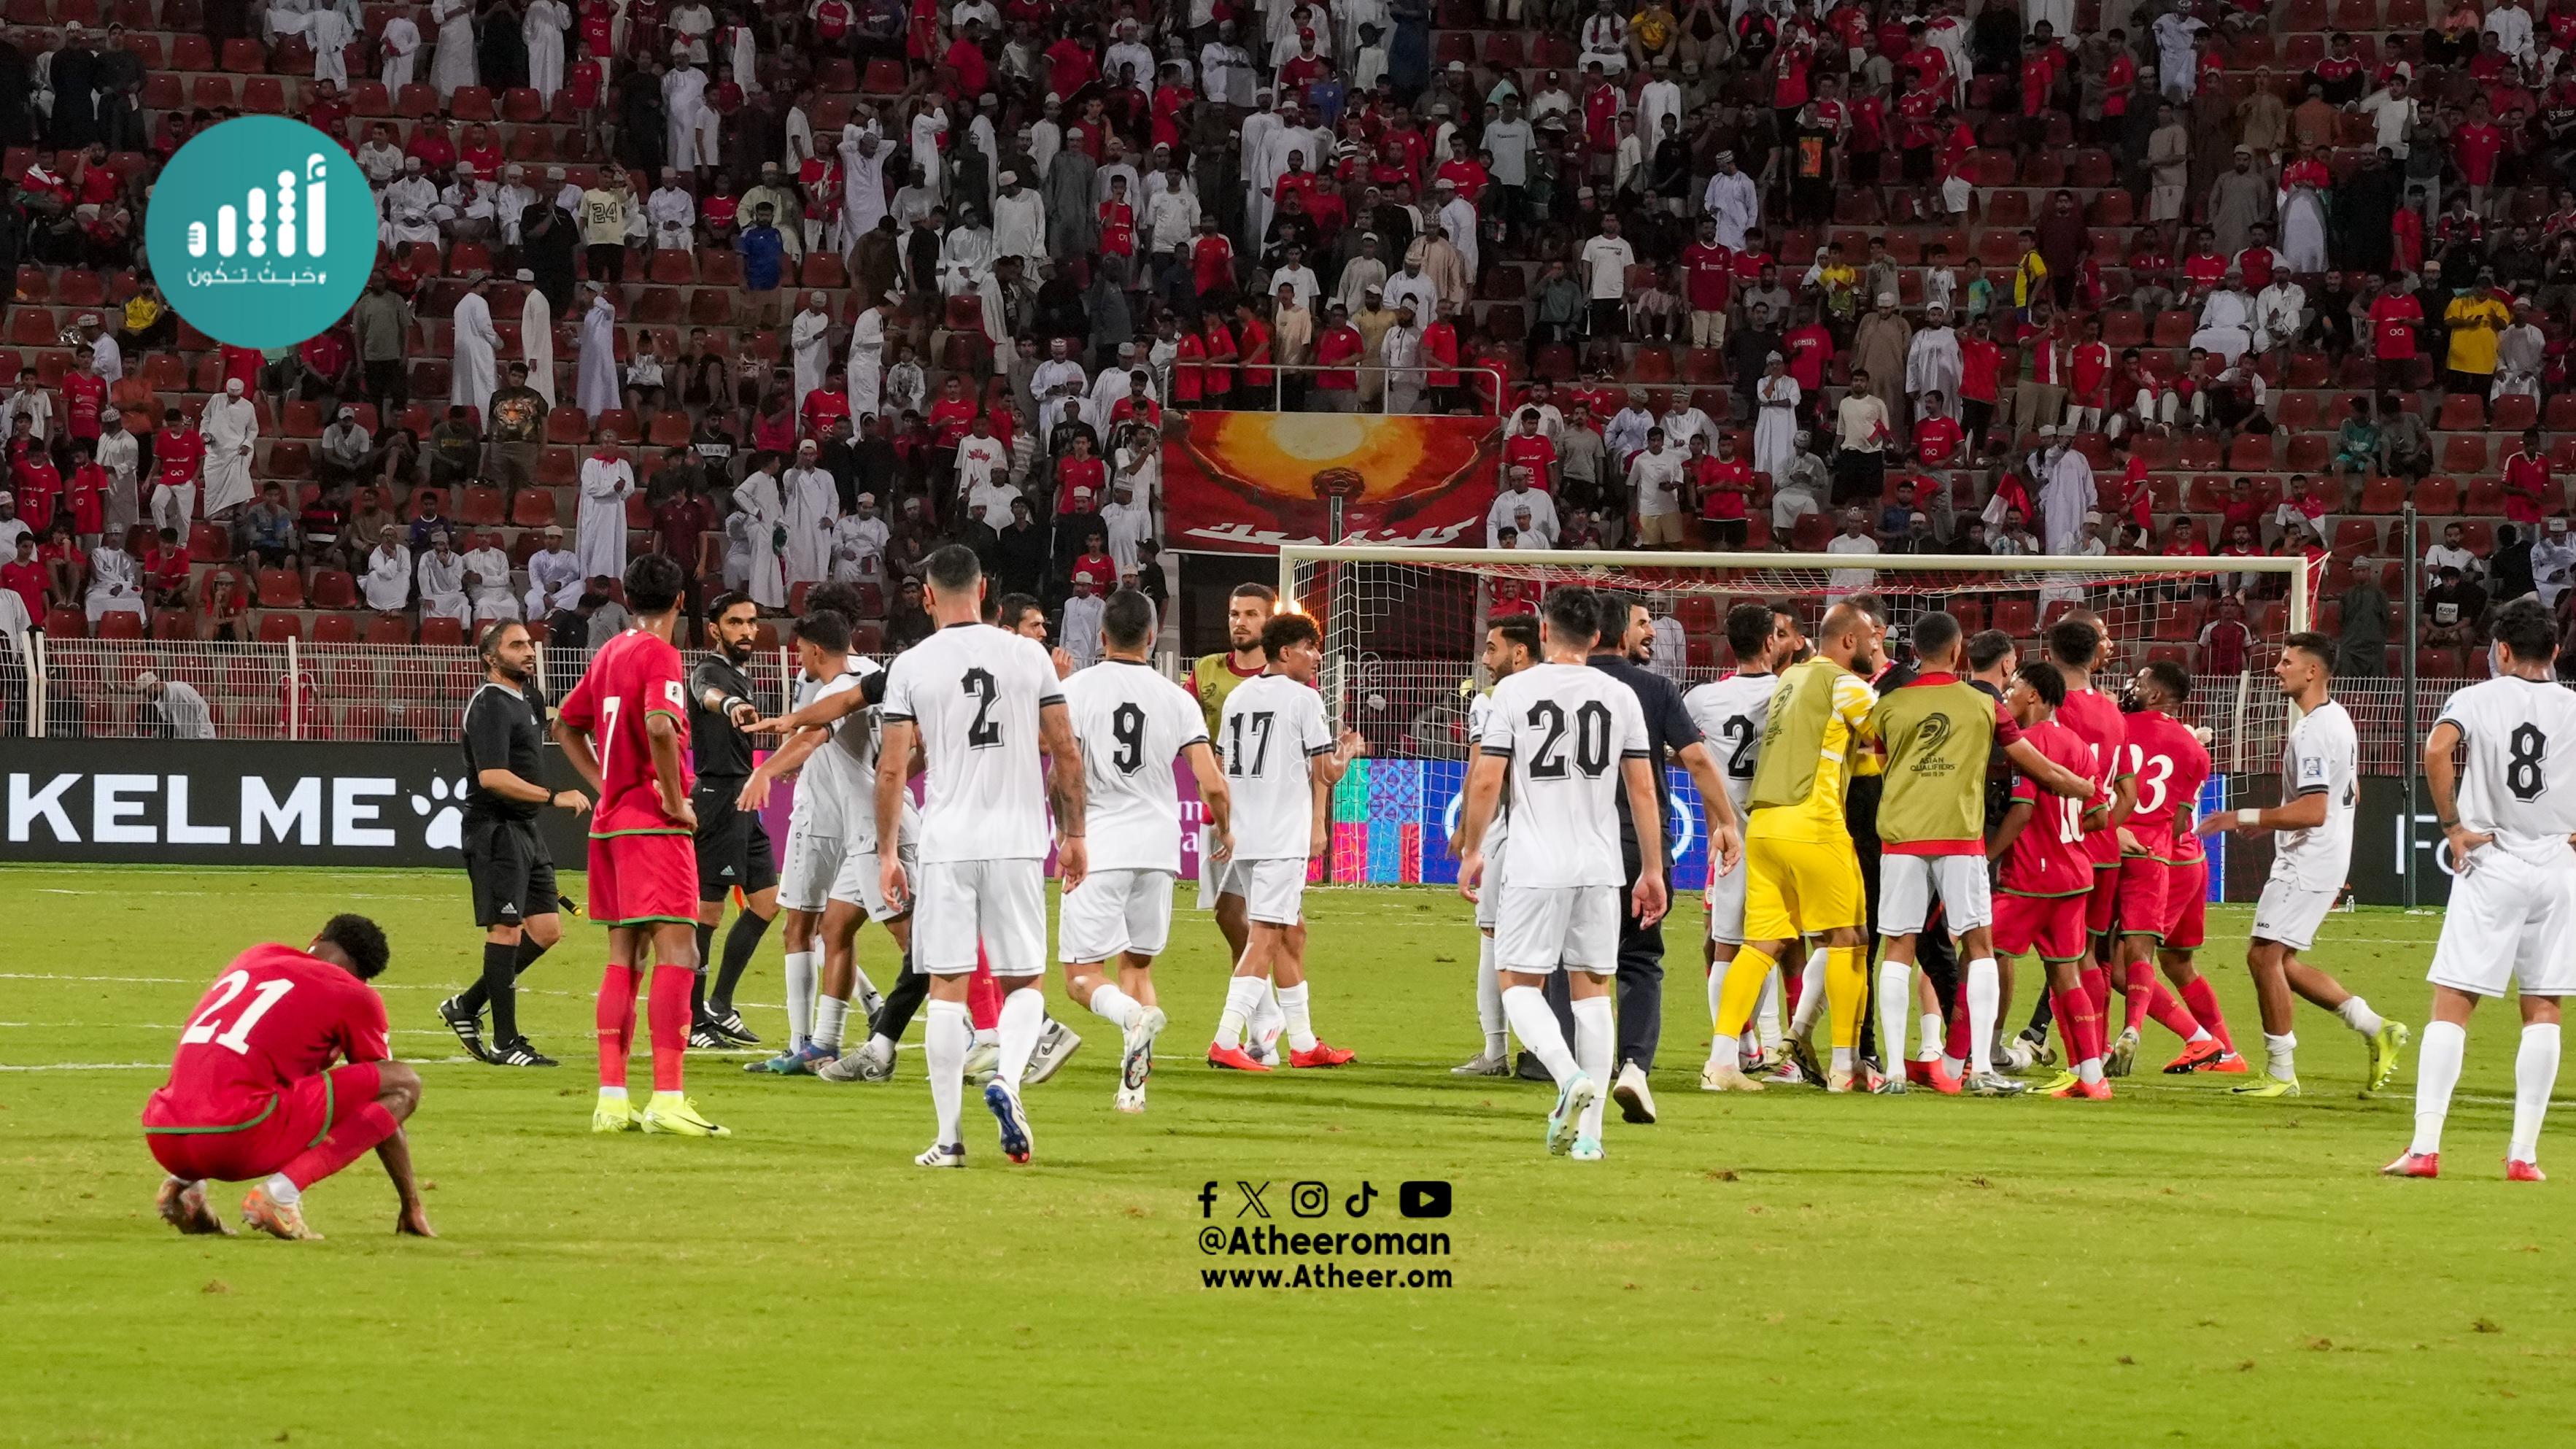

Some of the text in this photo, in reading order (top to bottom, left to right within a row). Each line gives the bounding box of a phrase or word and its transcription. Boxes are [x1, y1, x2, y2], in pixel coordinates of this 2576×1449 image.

[592, 202, 616, 224] 24
[602, 695, 621, 781] 7
[960, 666, 1005, 751] 2
[1113, 701, 1149, 777] 9
[1229, 711, 1277, 778] 17
[1527, 699, 1612, 781] 20
[2506, 721, 2548, 803] 8
[7, 772, 396, 846] KELME
[180, 969, 295, 1056] 21
